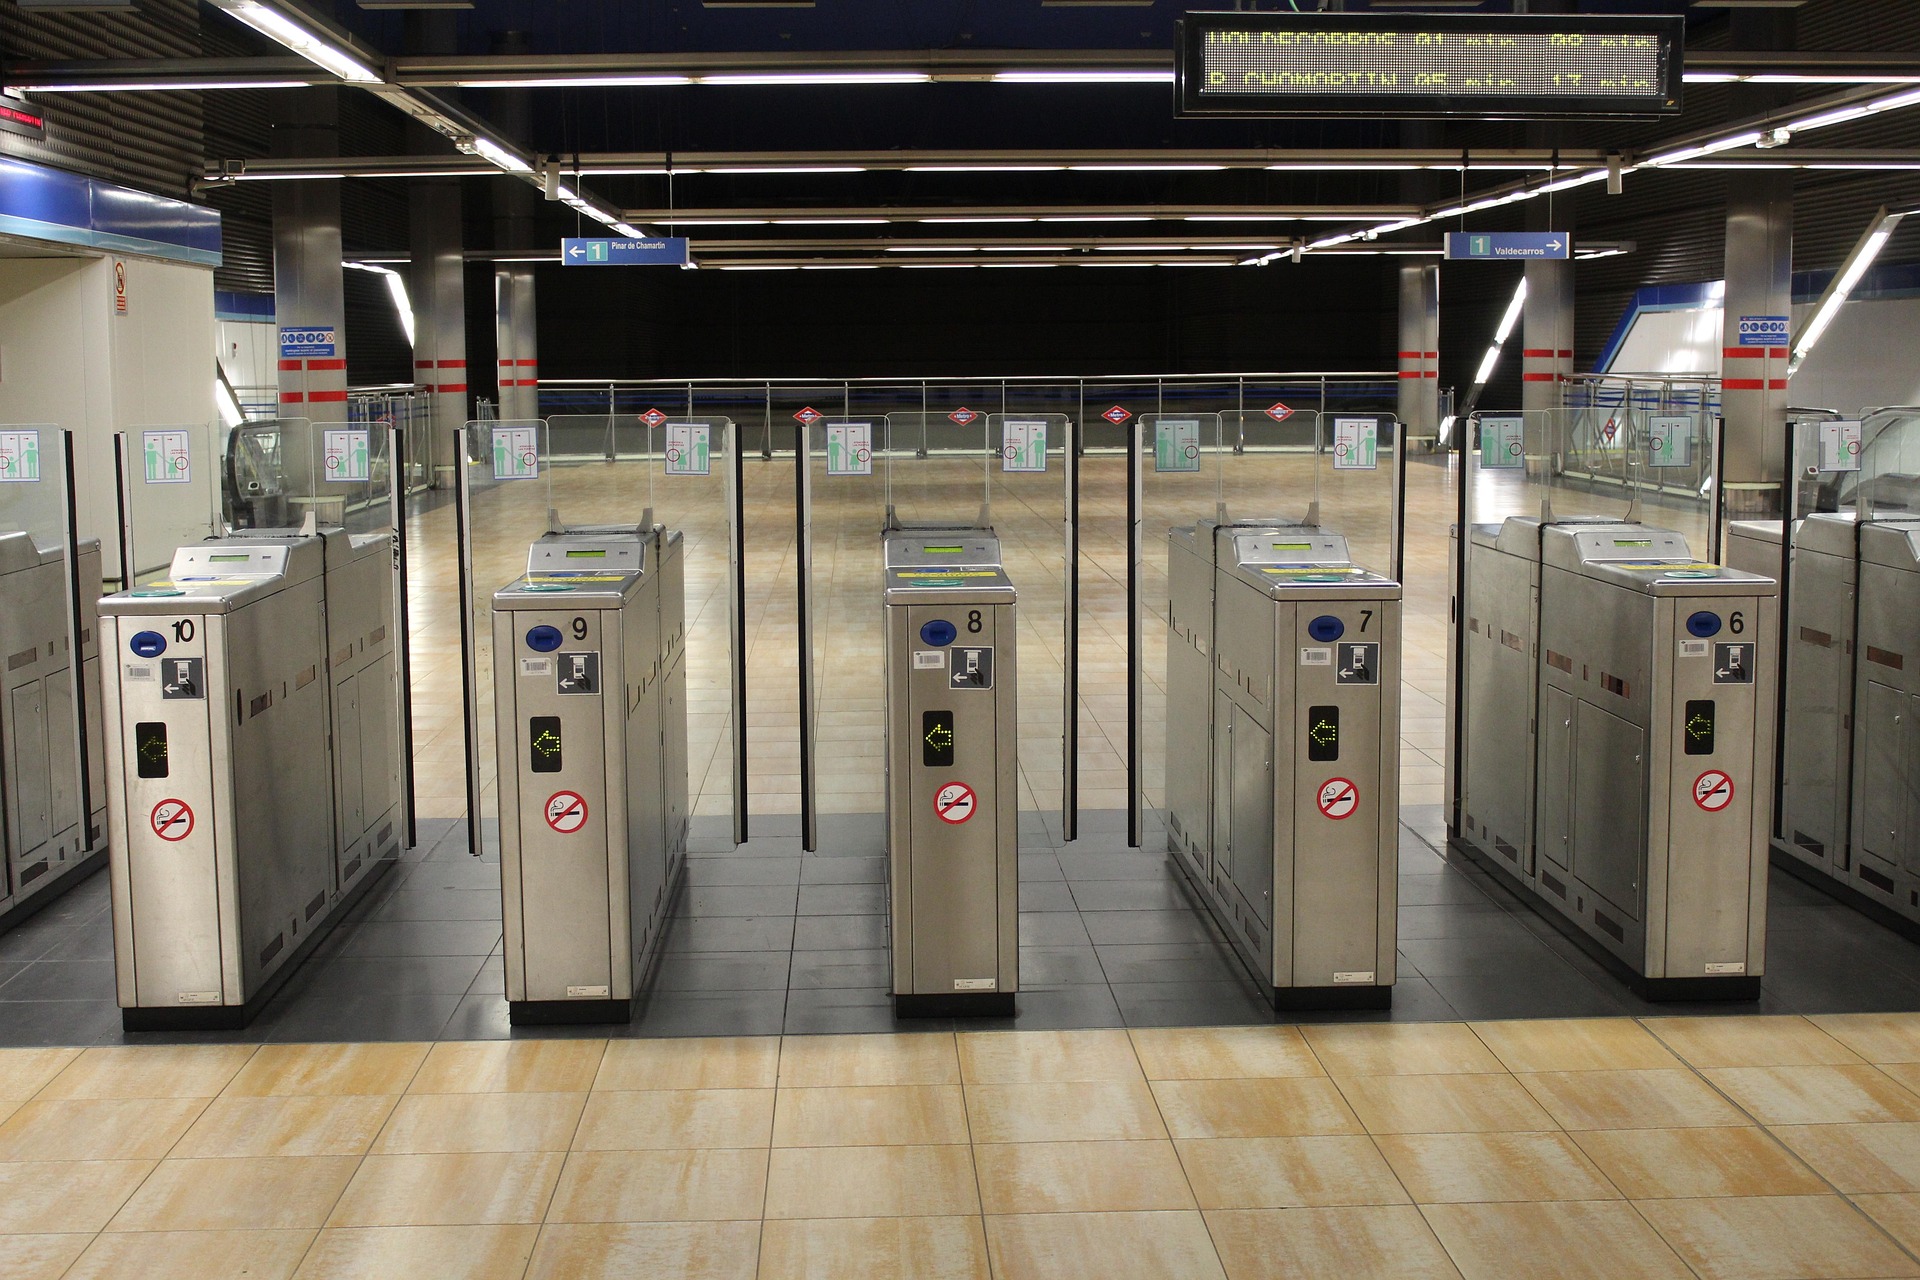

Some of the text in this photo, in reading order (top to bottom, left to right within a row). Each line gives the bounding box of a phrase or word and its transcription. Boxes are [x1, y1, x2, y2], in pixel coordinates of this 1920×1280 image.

[592, 243, 600, 260] 1
[611, 241, 627, 250] Pinar
[627, 241, 636, 250] de
[1475, 237, 1484, 254] 1
[1495, 247, 1545, 256] Valdecarros
[171, 618, 195, 643] 10
[572, 616, 588, 641] 9
[967, 609, 983, 634] 8
[1360, 609, 1373, 633] 7
[1729, 610, 1744, 635] 6
